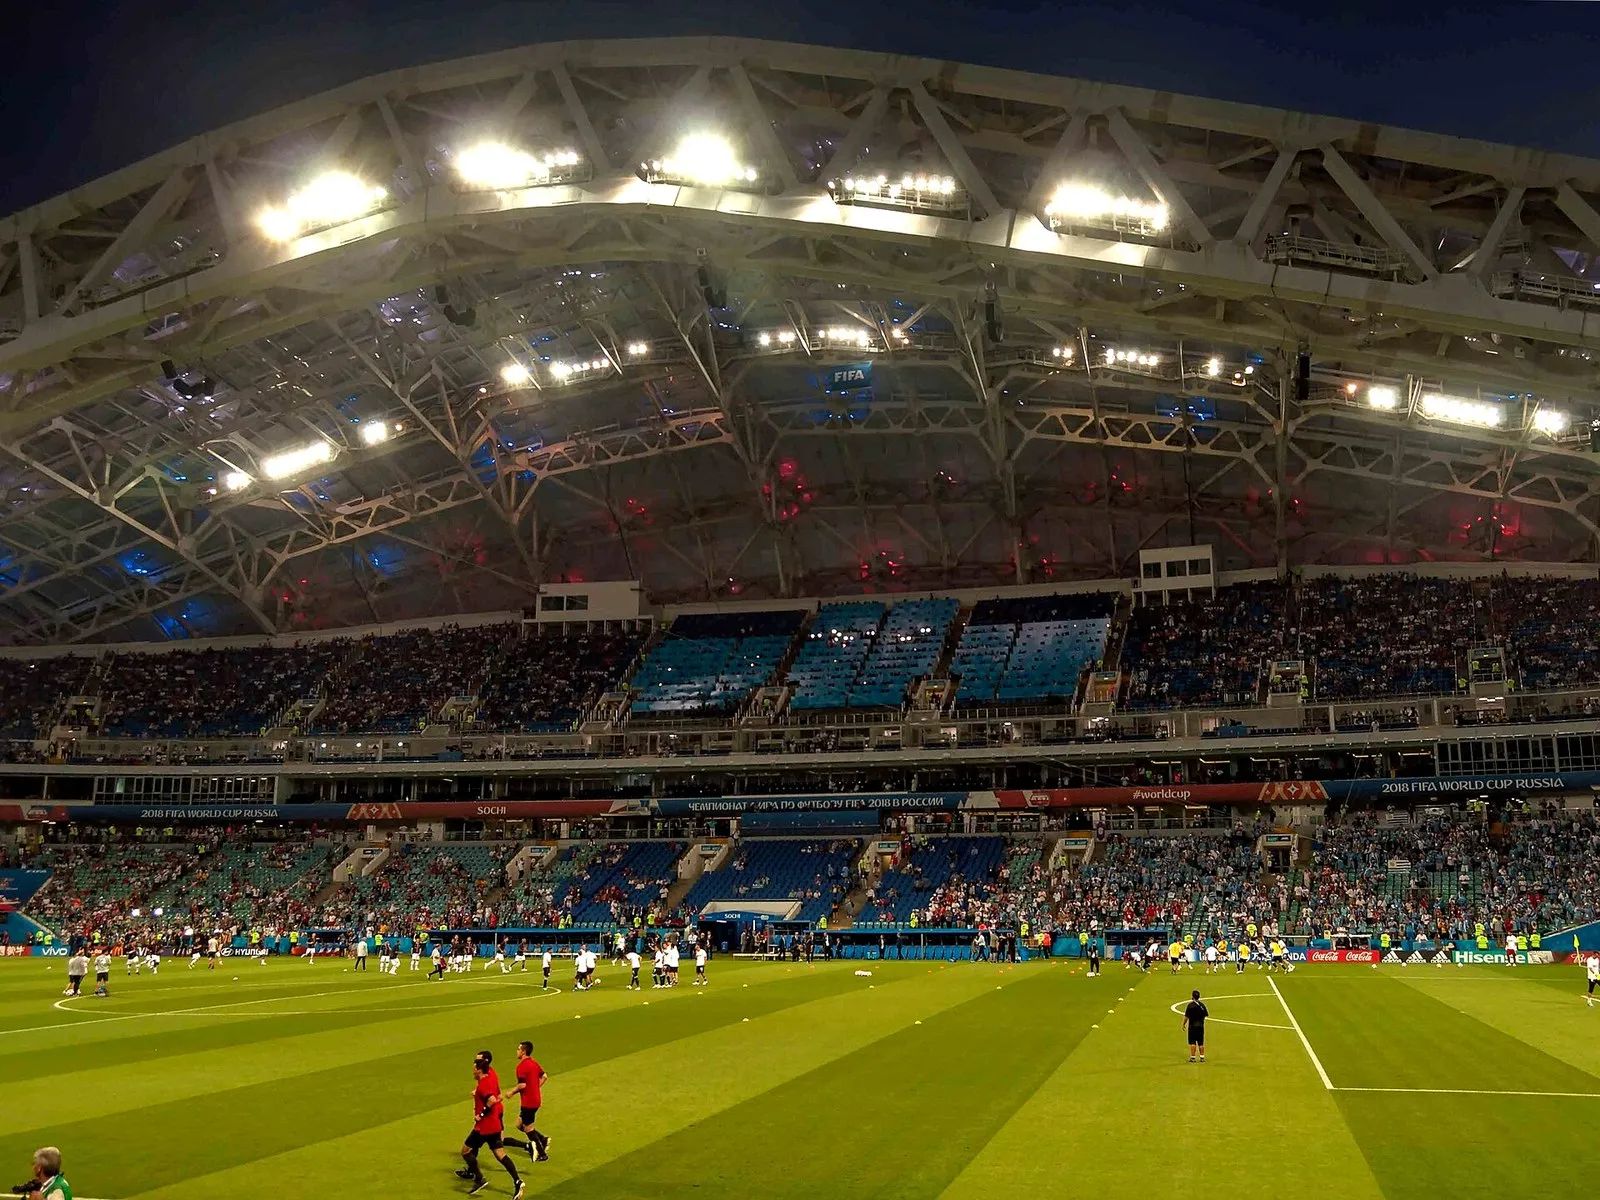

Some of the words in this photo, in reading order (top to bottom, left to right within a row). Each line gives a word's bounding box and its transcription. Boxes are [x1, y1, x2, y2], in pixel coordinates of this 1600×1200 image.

[834, 369, 865, 383] FIFA
[1381, 783, 1410, 793] 2018
[1411, 781, 1438, 792] FIFA
[1438, 780, 1484, 791] WORLD
[1486, 779, 1513, 790] CUP
[1515, 777, 1565, 789] RUSSIA
[1132, 789, 1191, 800] #worldcup
[688, 802, 747, 811] ЧЕМПИОНАТ
[781, 801, 796, 810] ПО
[845, 799, 866, 808] FIFA
[868, 799, 891, 808] 2018
[901, 797, 944, 807] РОССИИ
[141, 809, 164, 818] 2018
[165, 809, 186, 818] FIFA
[187, 809, 221, 818] WORLD
[222, 809, 242, 818] CUP
[243, 808, 279, 818] RUSSIA
[477, 806, 507, 815] SOCHI
